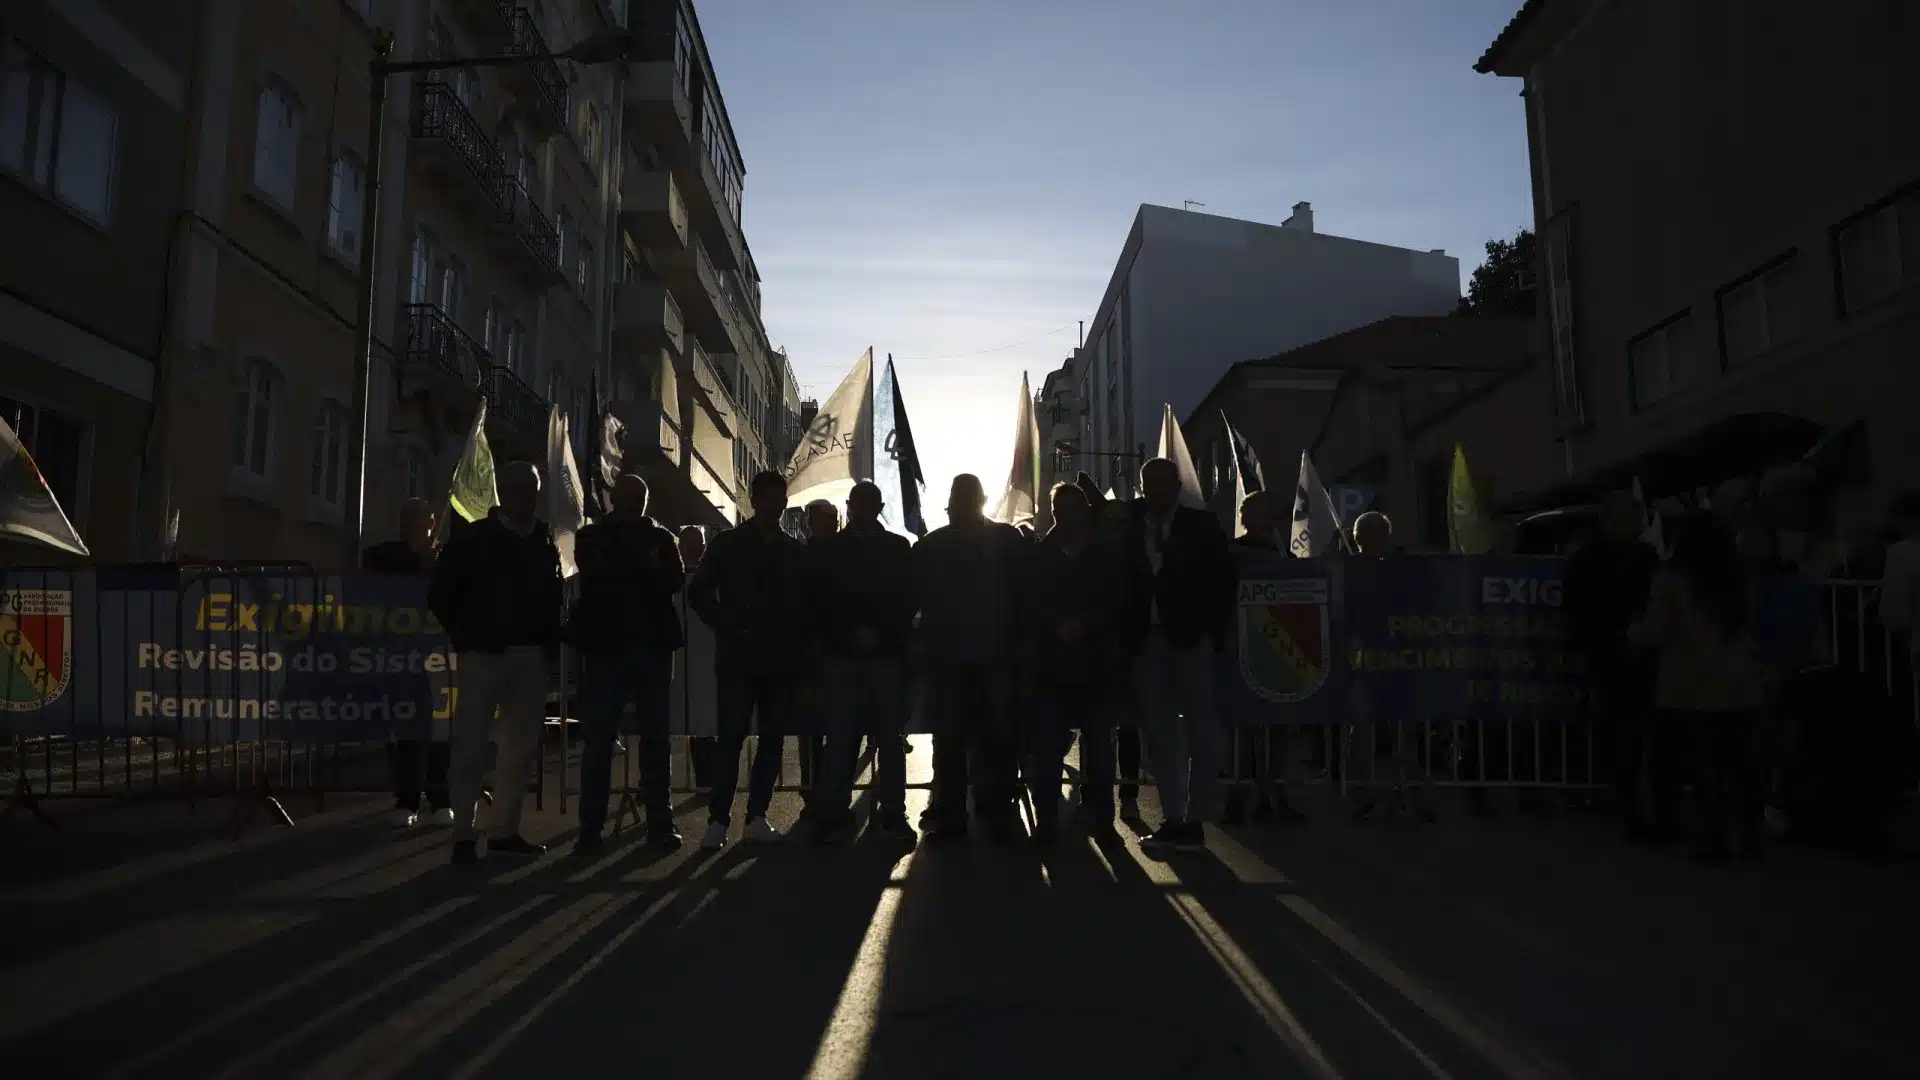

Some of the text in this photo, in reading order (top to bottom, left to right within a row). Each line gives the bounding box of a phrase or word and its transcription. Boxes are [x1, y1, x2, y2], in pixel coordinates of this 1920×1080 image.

[1340, 488, 1364, 521] P
[1240, 584, 1276, 601] APG
[1482, 576, 1563, 606] EXIG
[138, 643, 284, 672] Revisão
[292, 647, 338, 673] do
[133, 690, 417, 721] Remuneratório
